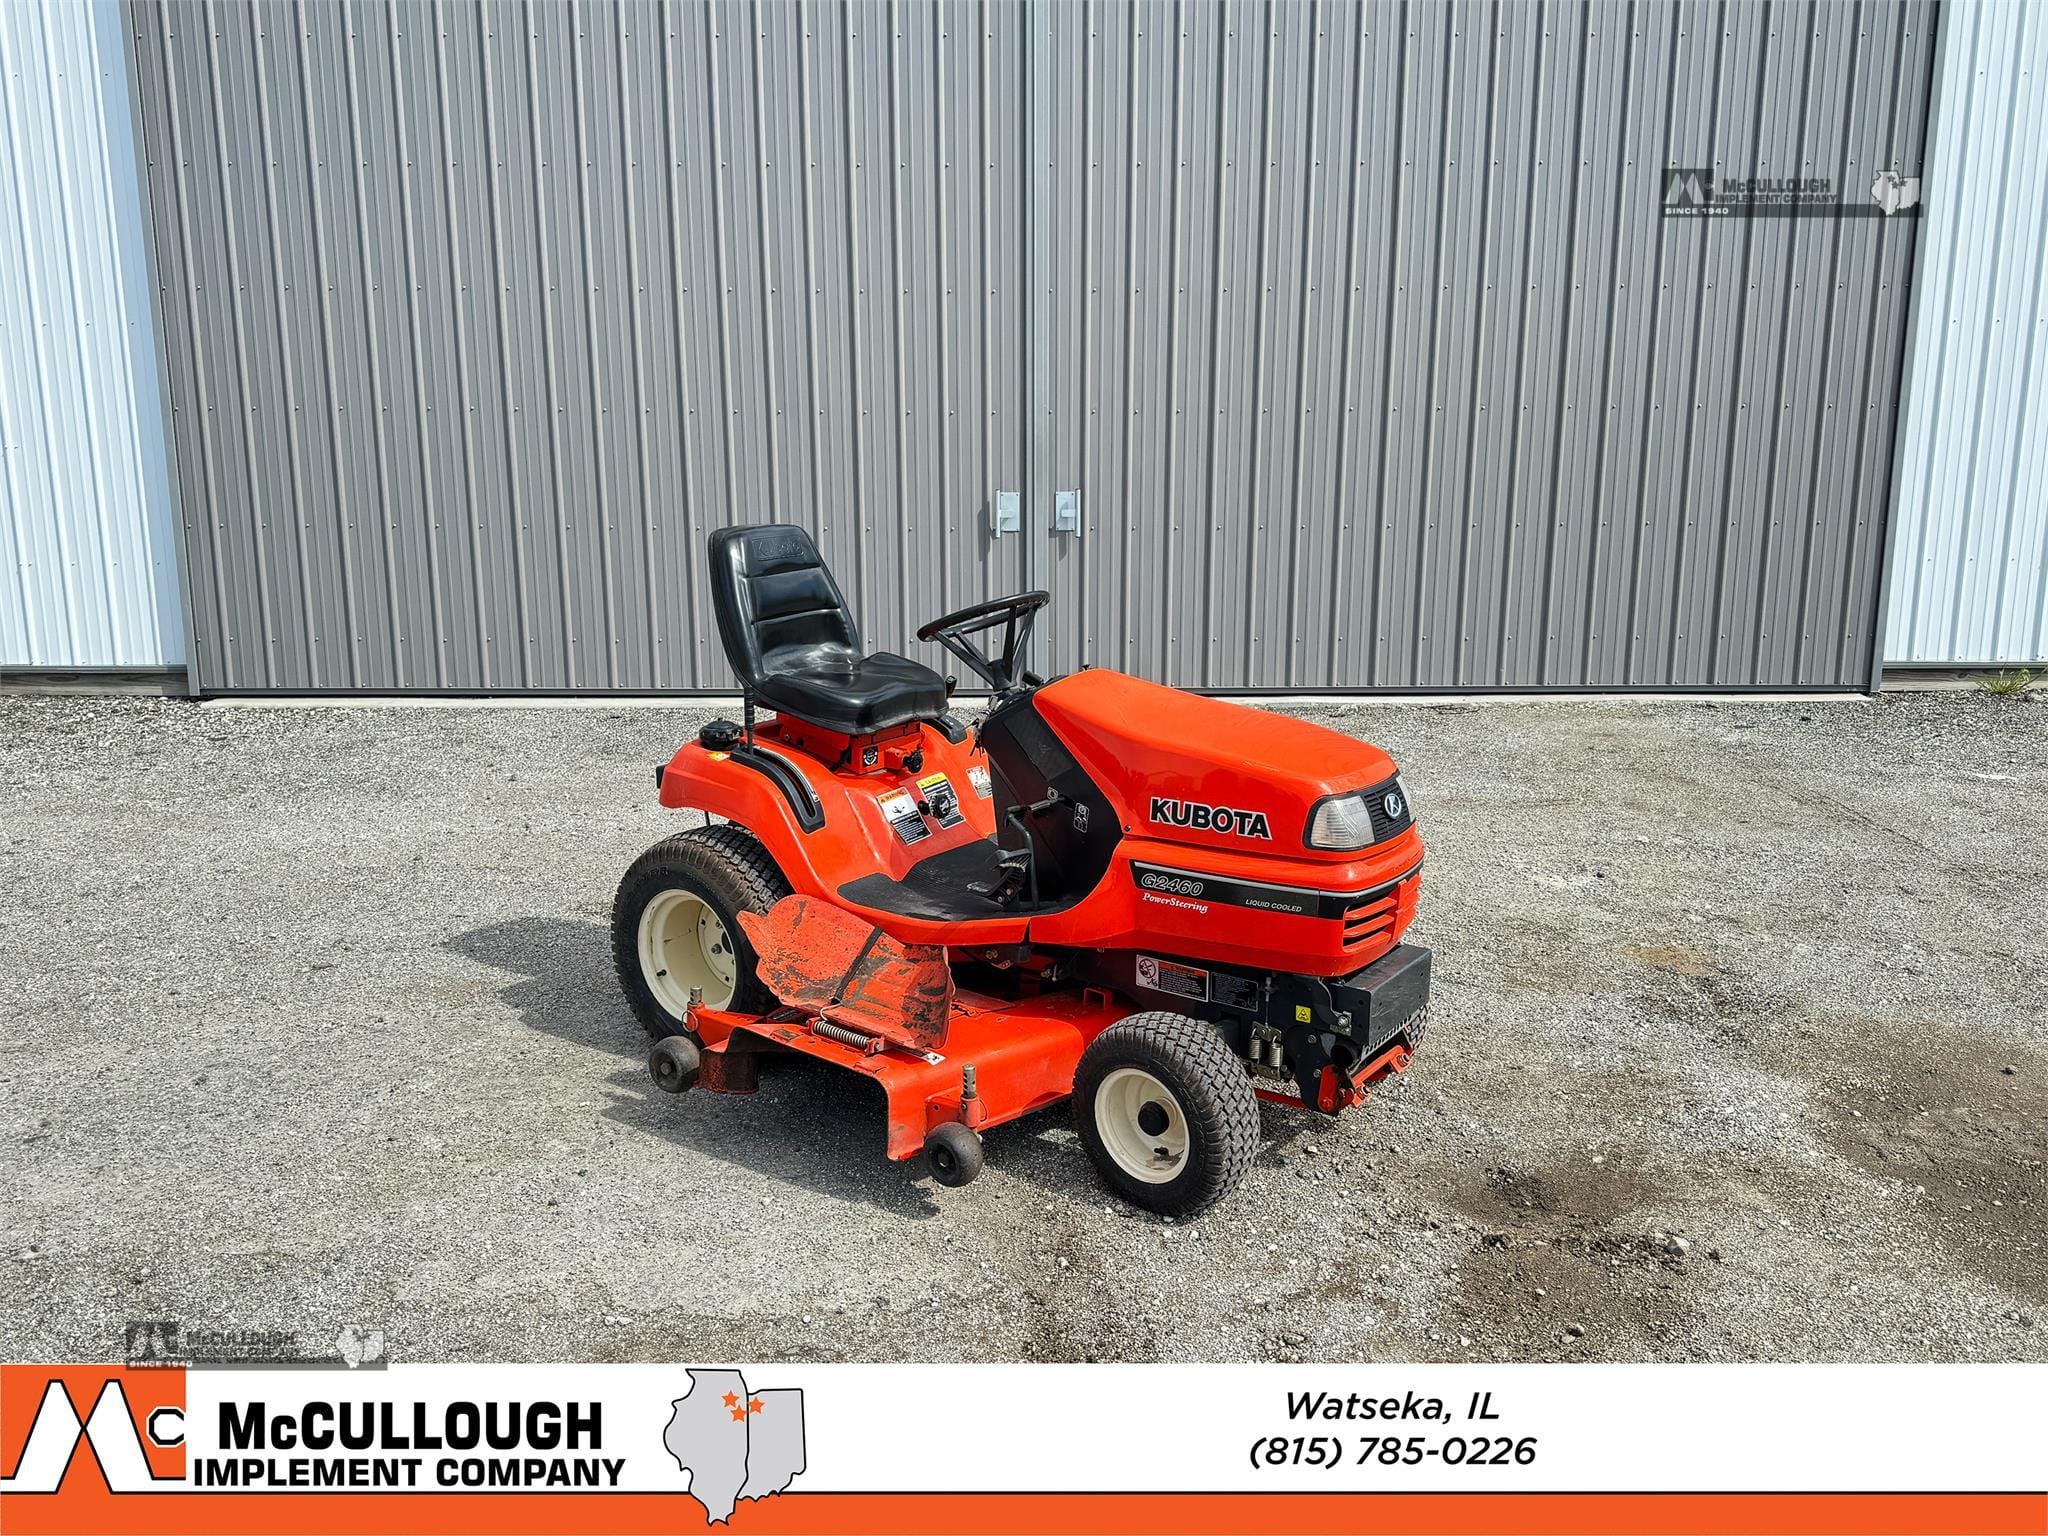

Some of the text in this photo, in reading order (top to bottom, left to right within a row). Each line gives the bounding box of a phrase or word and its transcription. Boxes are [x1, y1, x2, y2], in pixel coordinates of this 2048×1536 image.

[1150, 797, 1272, 840] KUBOTA
[1141, 873, 1204, 896] G2460
[1143, 892, 1209, 914] PowerSteering
[1245, 899, 1302, 912] LIQUID COOLED
